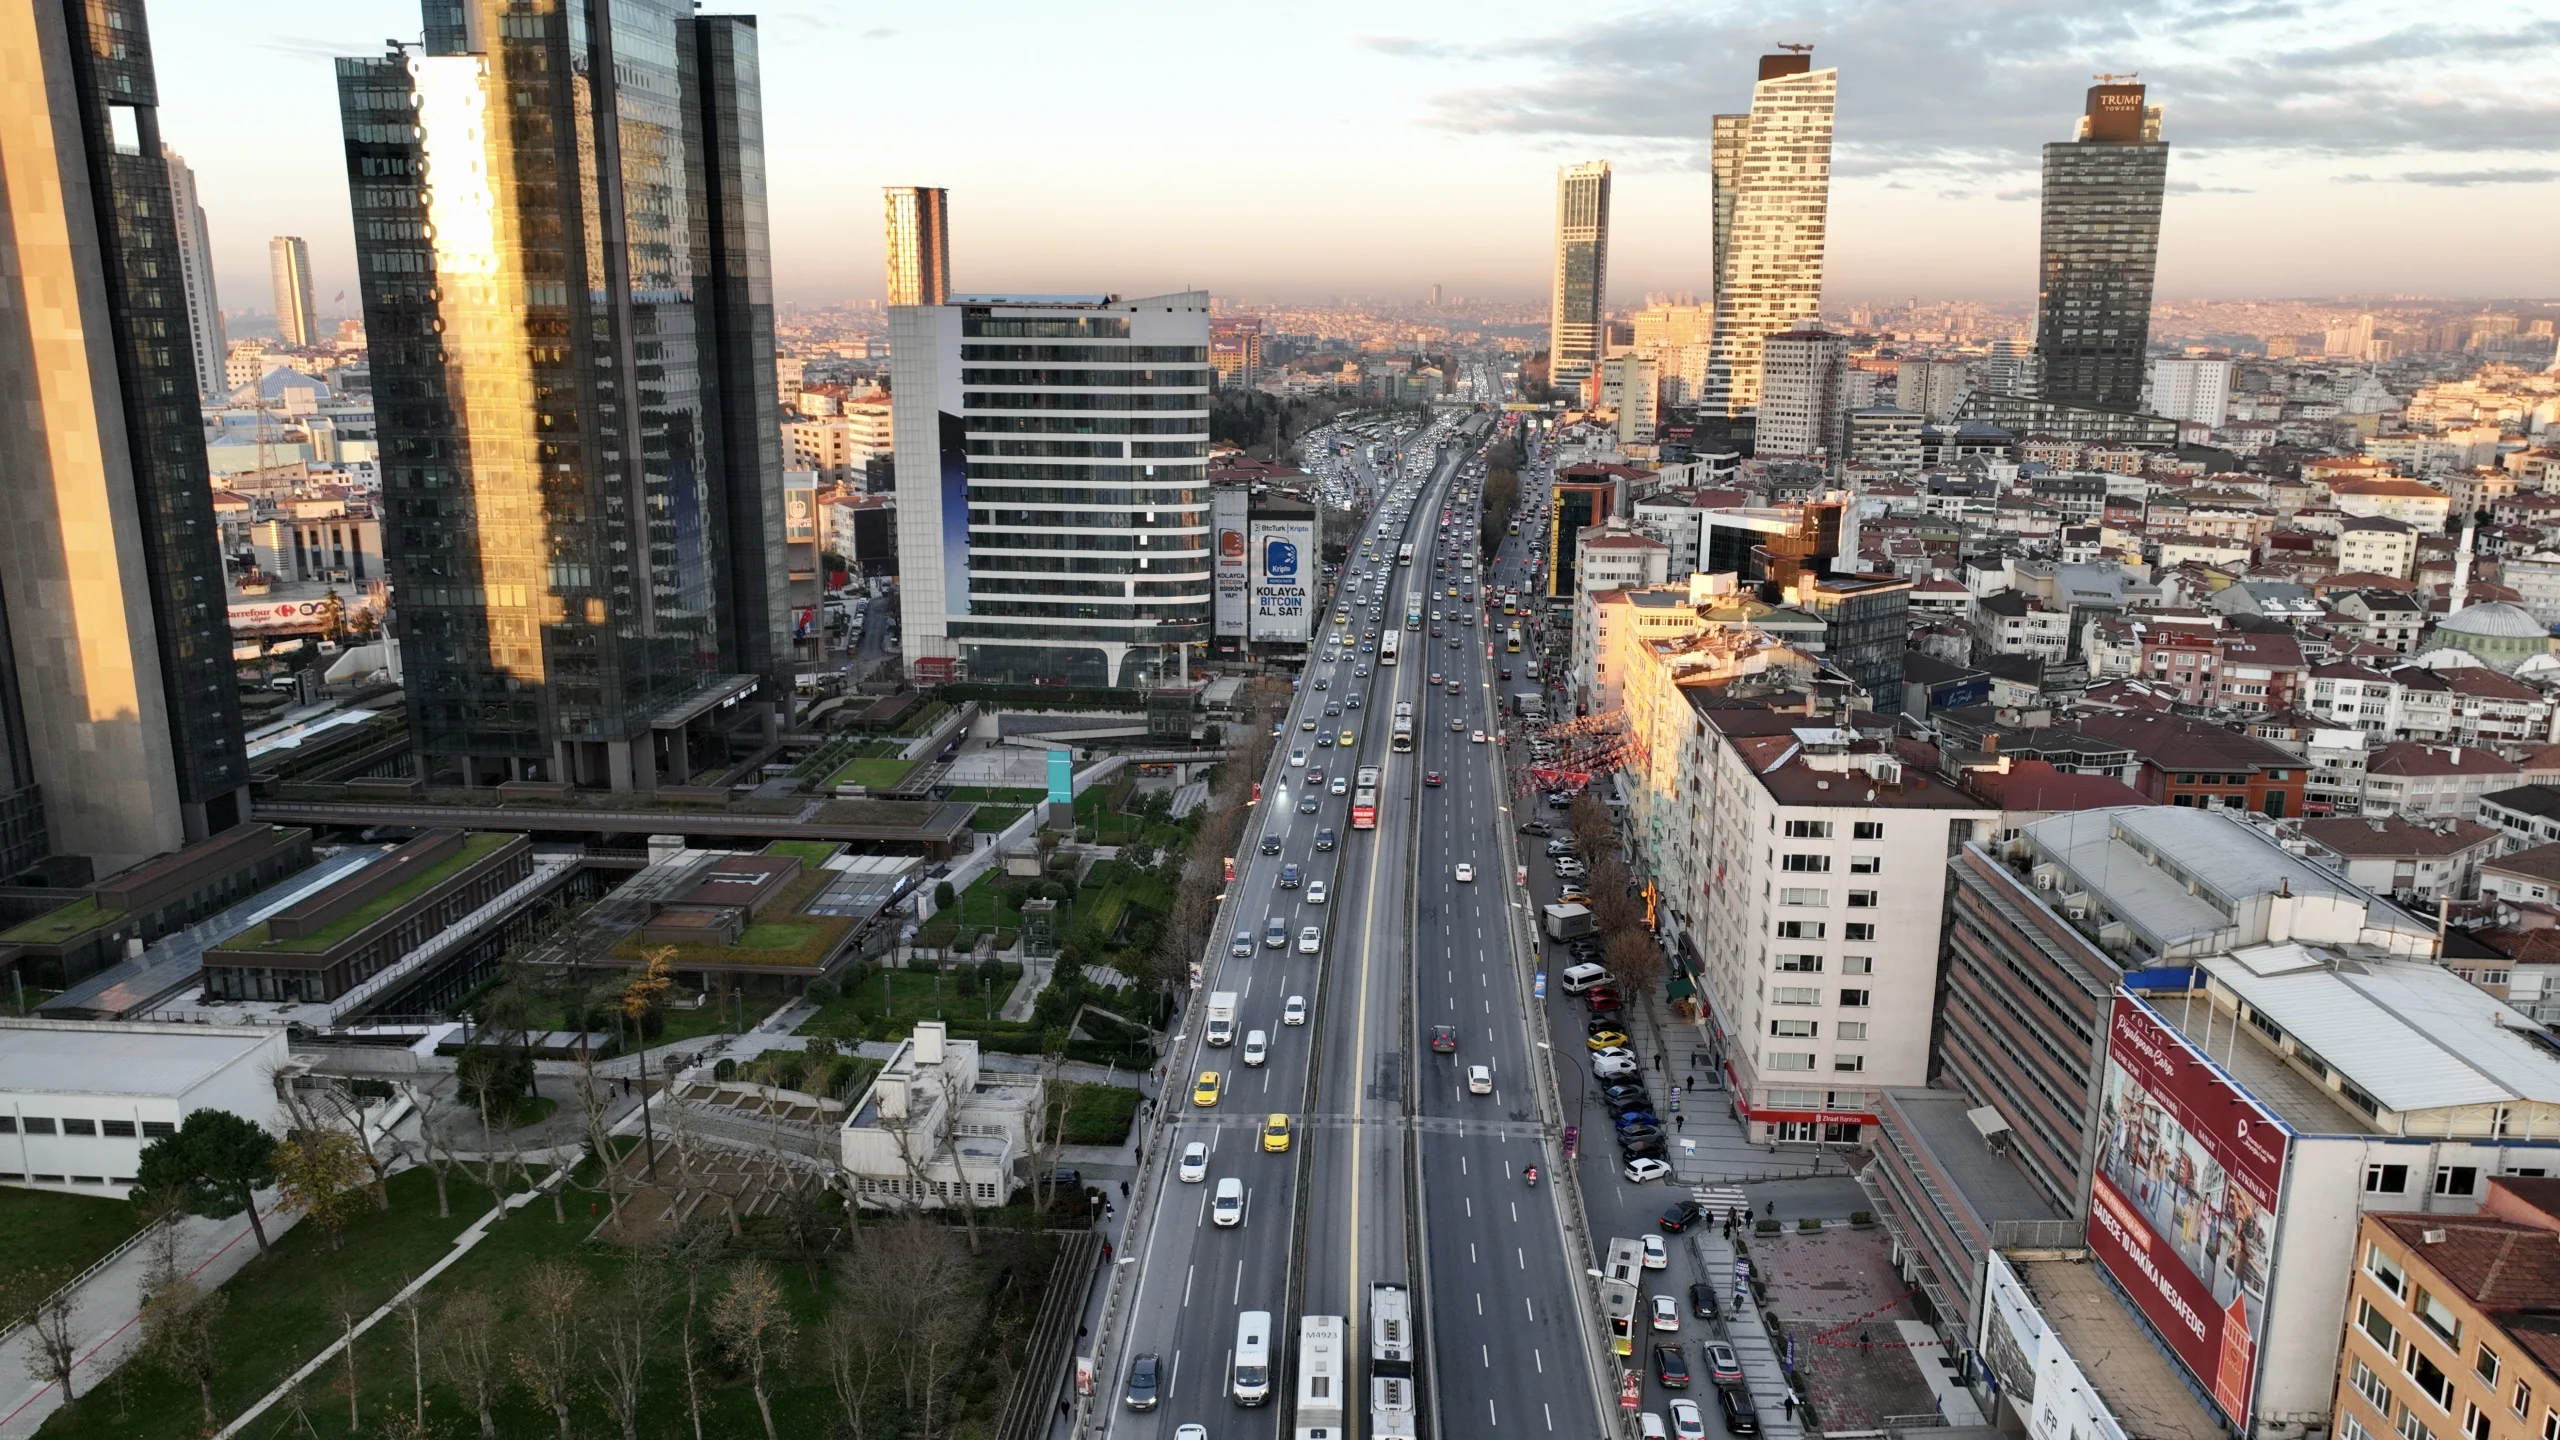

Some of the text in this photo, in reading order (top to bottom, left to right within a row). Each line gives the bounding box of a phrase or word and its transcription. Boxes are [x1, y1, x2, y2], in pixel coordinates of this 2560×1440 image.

[2101, 95, 2142, 105] TRUMP
[1290, 525, 1309, 533] Kripto
[1272, 565, 1291, 573] Kripto
[1256, 587, 1306, 597] KOLAYCA
[1260, 596, 1302, 607] BITCOIN
[1259, 606, 1303, 617] AL, SAT!
[2131, 1013, 2163, 1046] POLAT
[2197, 1129, 2216, 1152] SANAT
[2237, 1168, 2268, 1203] ETKİNLİK
[2093, 1198, 2206, 1343] SADECE 10 DAKİKA MESAFEDE!
[1306, 1331, 1338, 1339] M4923
